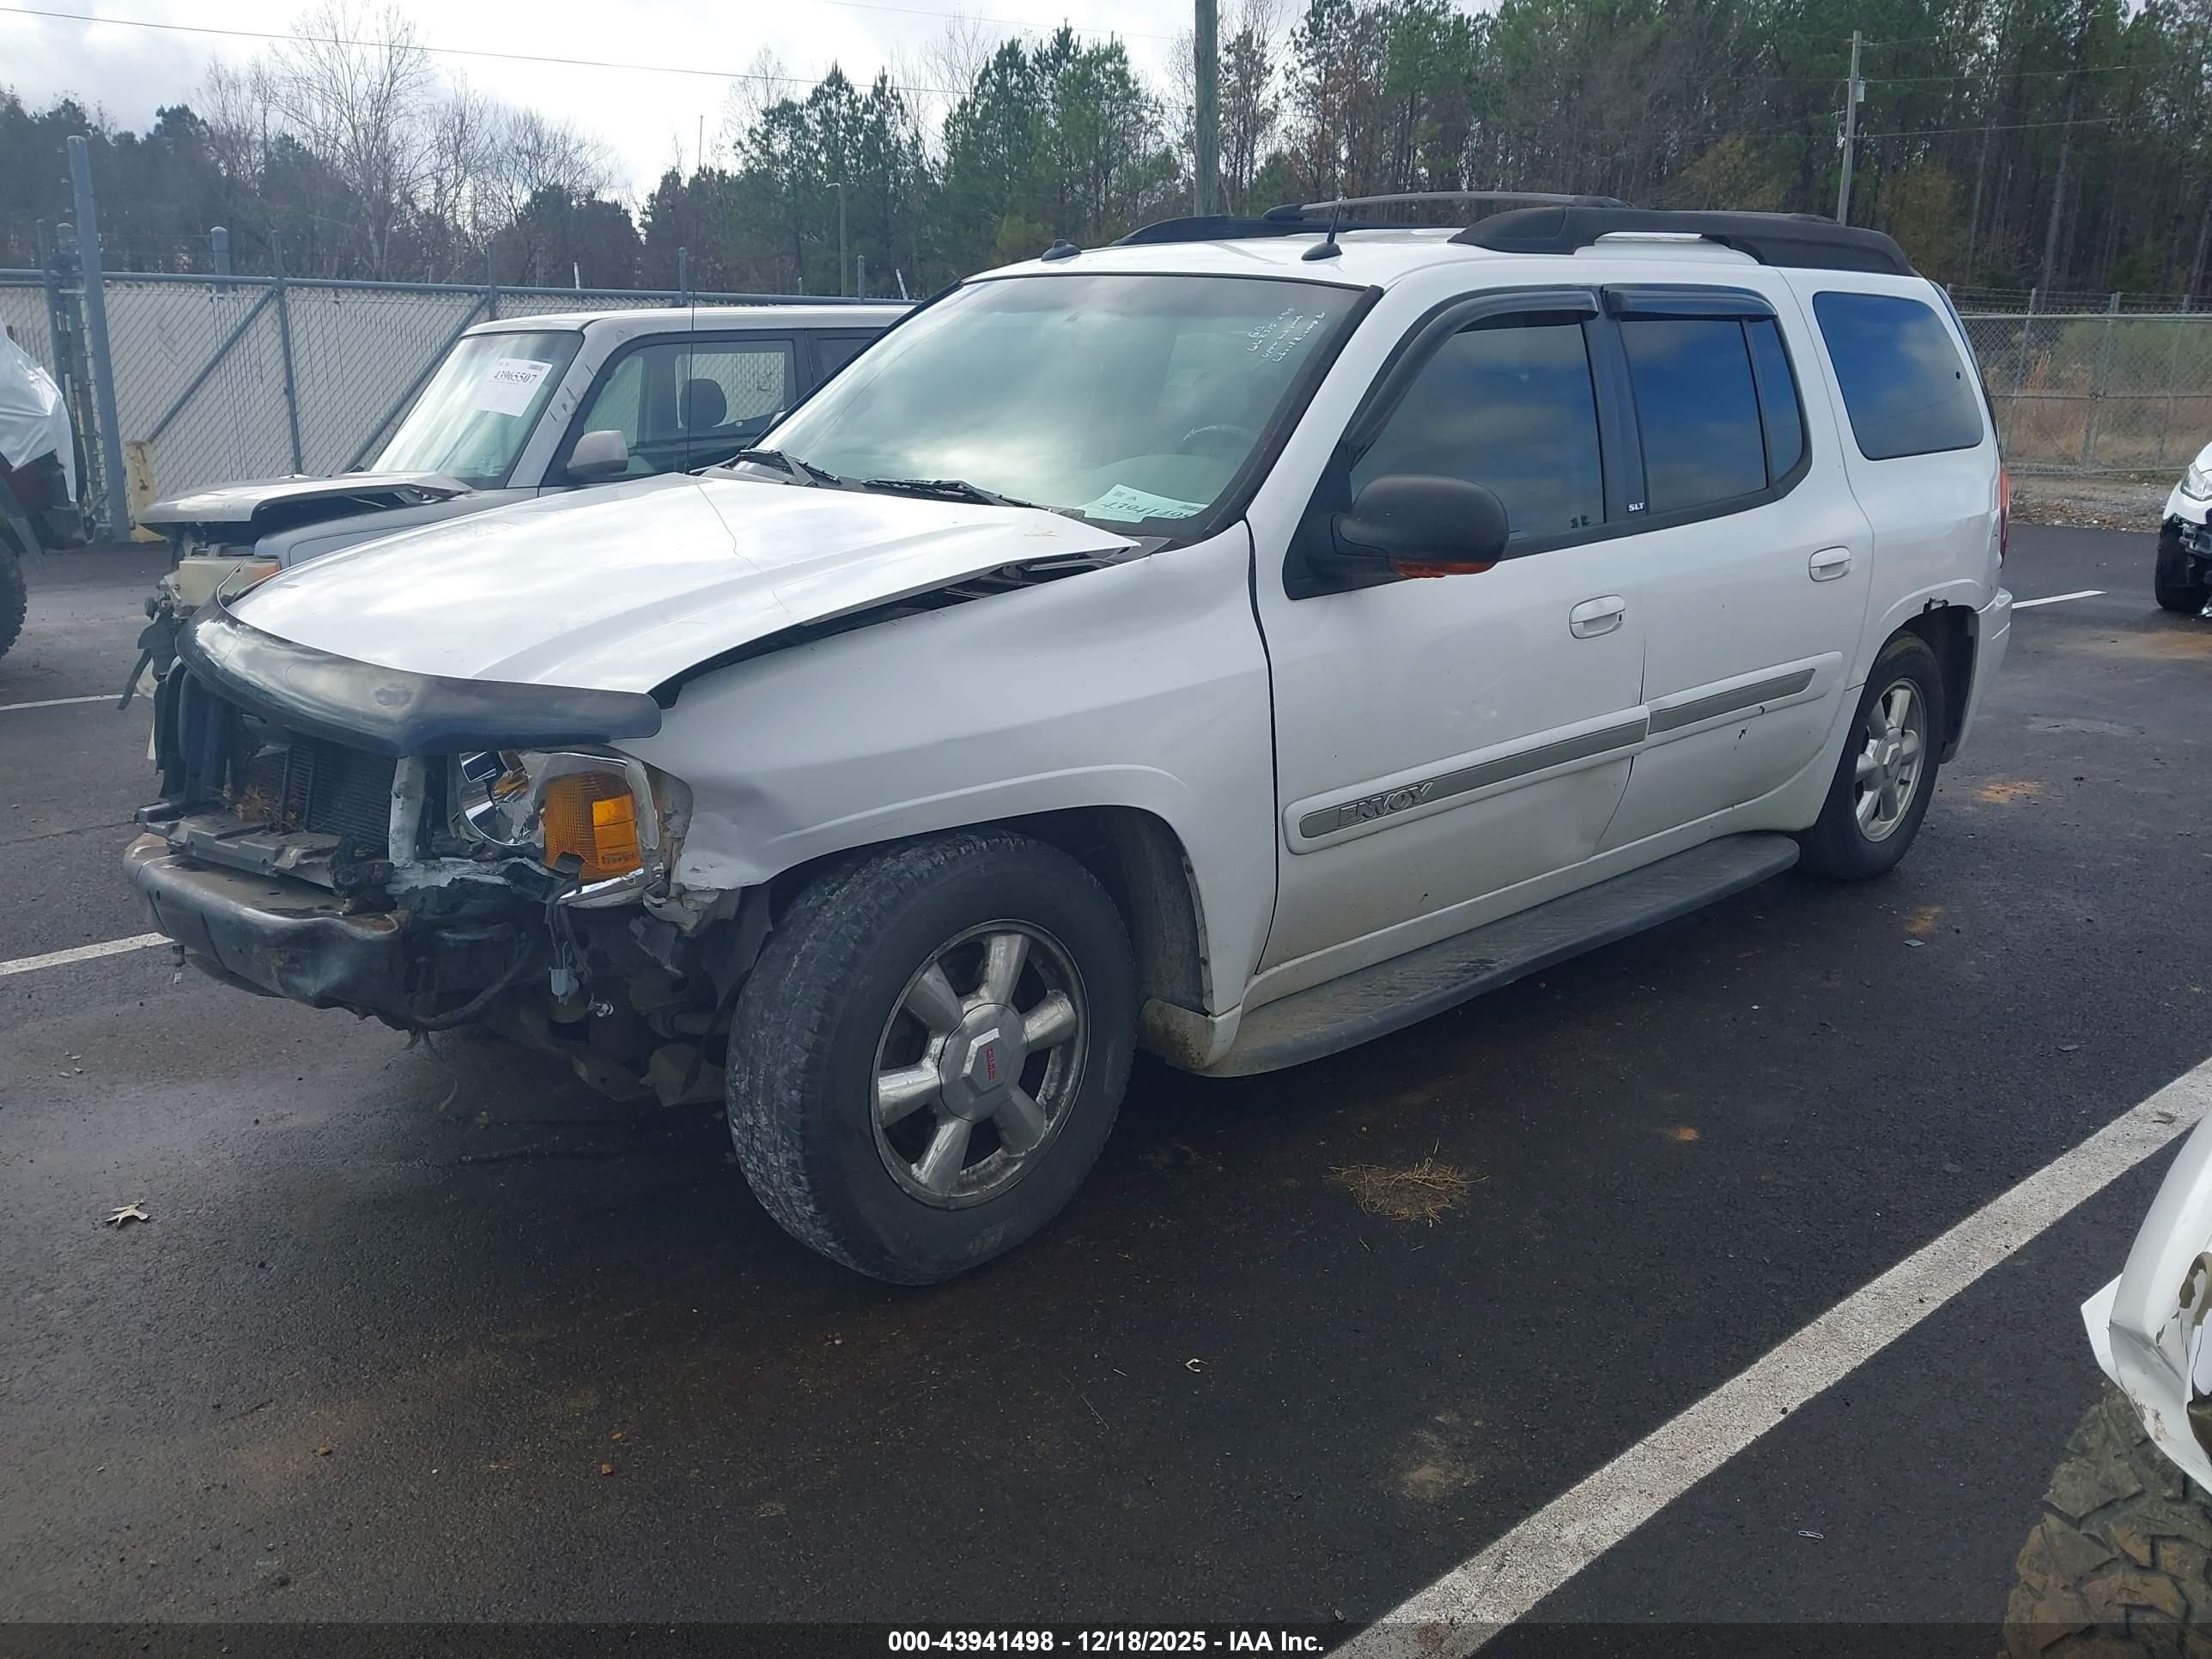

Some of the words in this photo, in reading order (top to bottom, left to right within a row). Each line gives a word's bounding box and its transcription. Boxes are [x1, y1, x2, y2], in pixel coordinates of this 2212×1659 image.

[494, 370, 538, 385] 43965507
[1628, 502, 1644, 512] SLT
[1338, 781, 1433, 827] ENVOY
